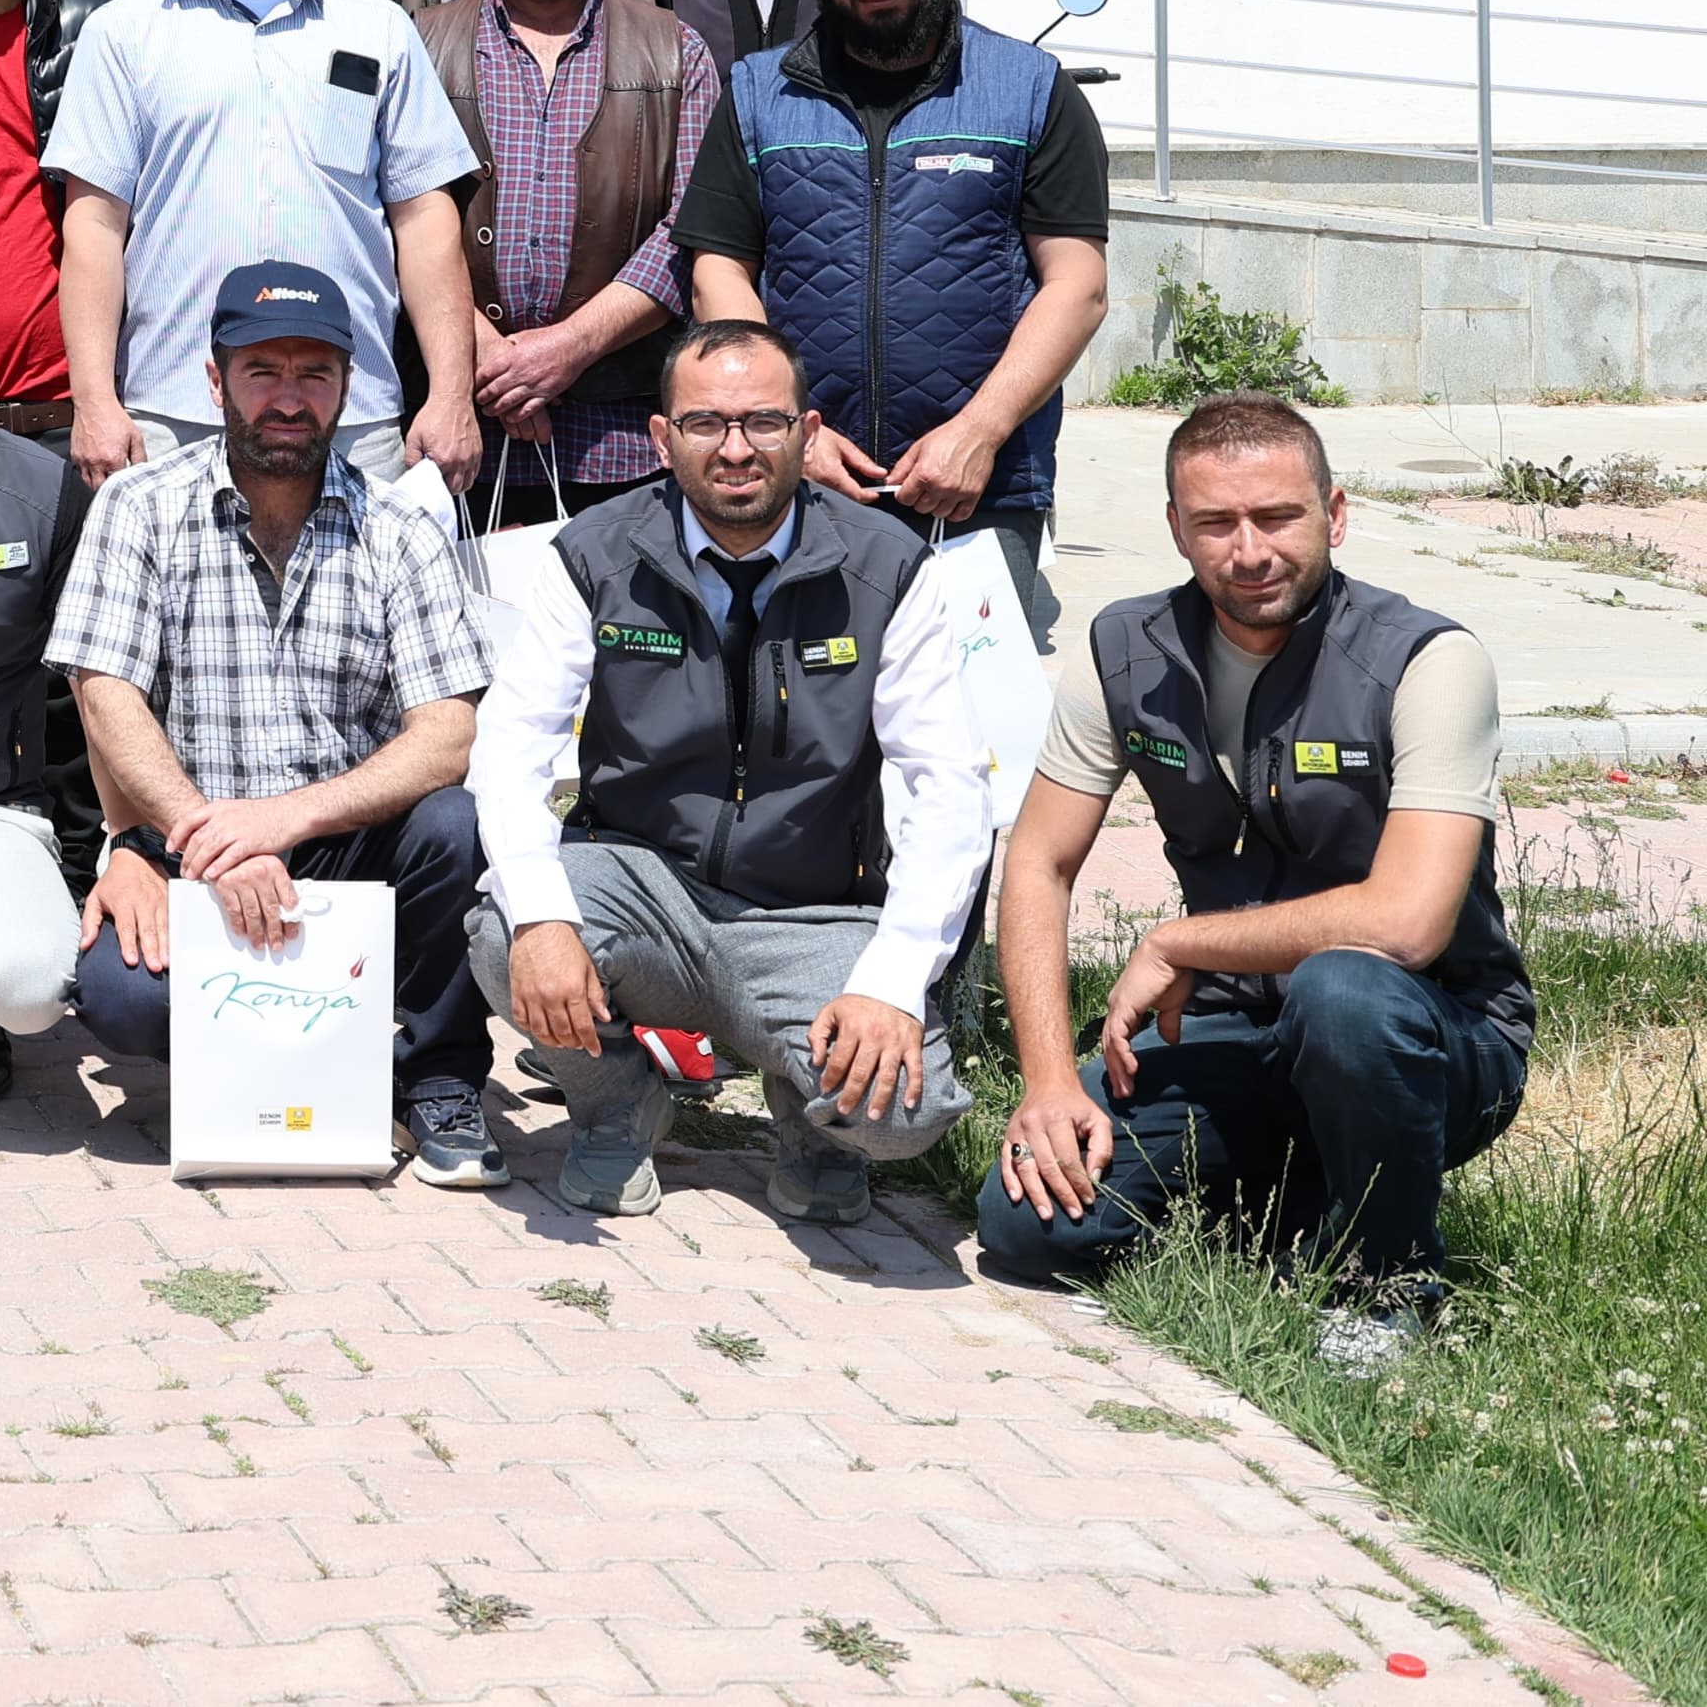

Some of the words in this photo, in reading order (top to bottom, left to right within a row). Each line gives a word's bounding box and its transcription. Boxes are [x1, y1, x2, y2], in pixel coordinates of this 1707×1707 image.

[621, 629, 682, 647] TARIM
[1143, 736, 1186, 760] TARIM
[201, 972, 361, 1033] Konya
